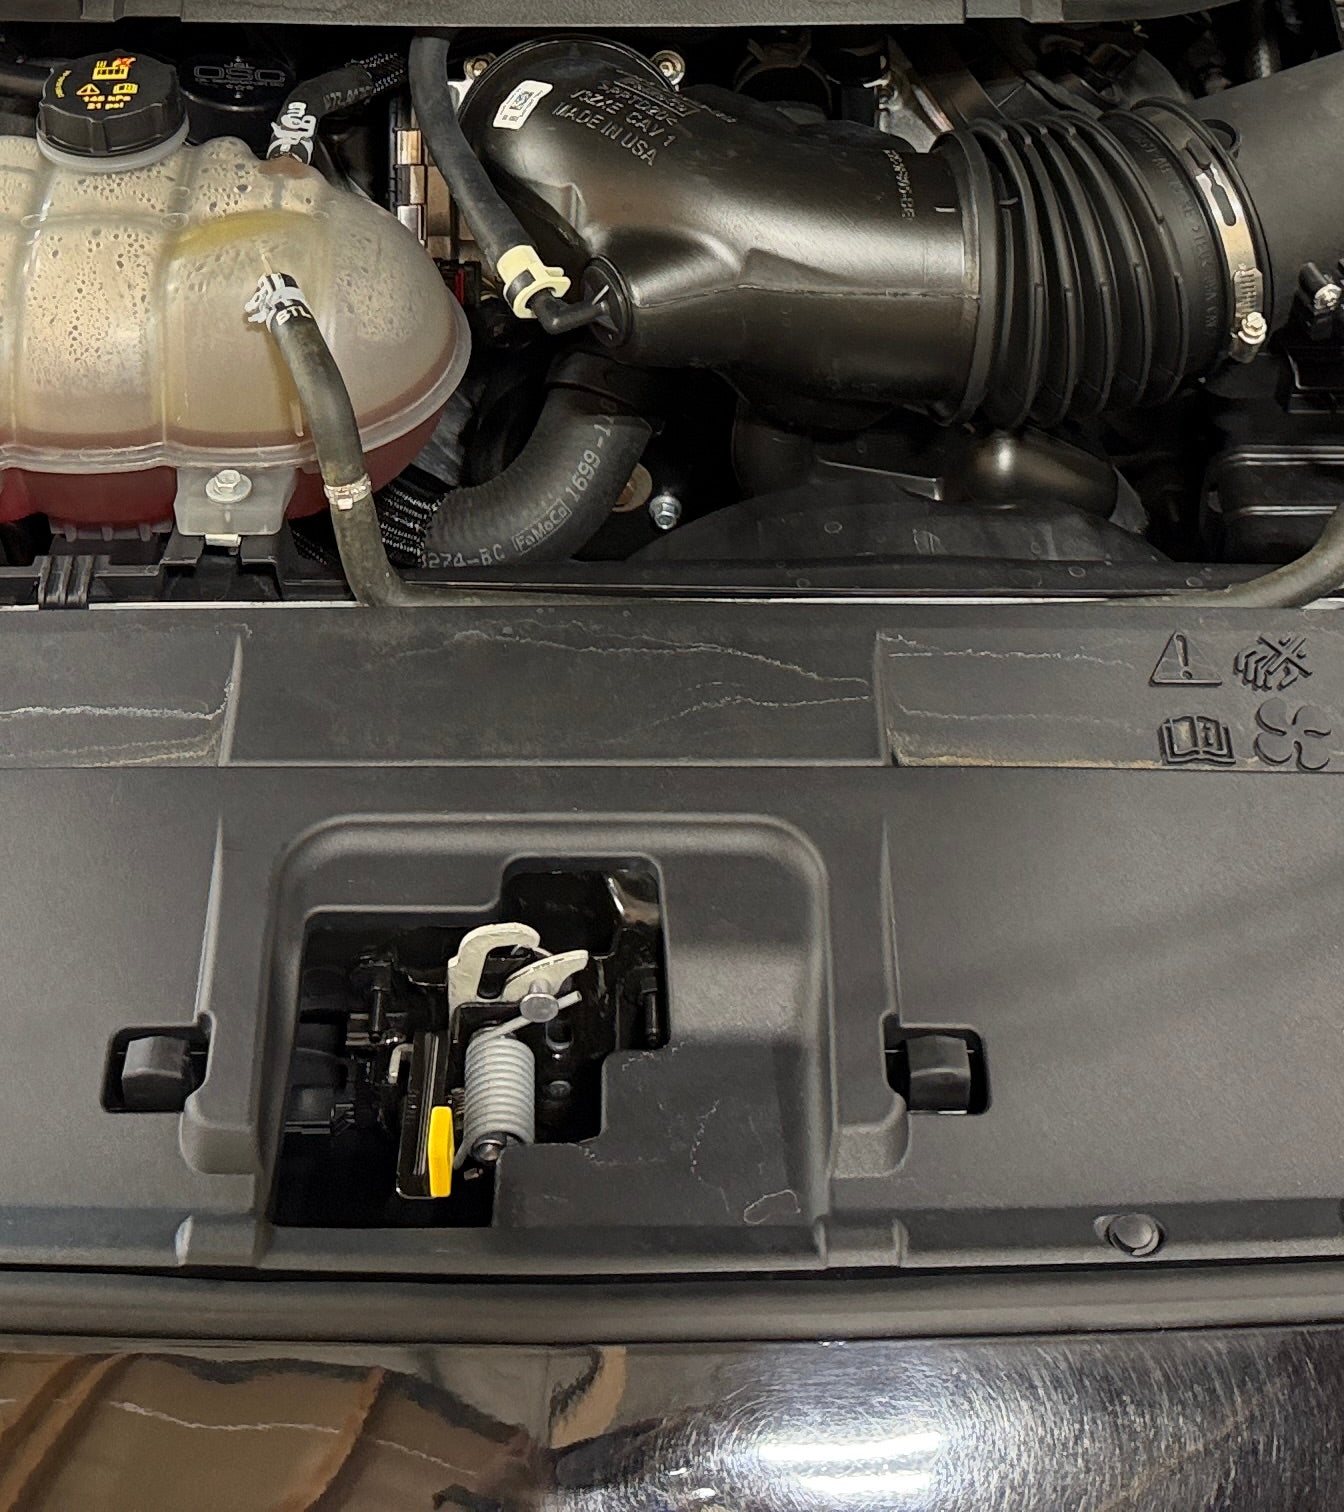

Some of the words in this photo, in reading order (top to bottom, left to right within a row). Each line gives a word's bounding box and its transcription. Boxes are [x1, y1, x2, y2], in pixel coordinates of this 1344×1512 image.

[552, 101, 605, 129] MADE
[600, 120, 623, 140] IN
[620, 132, 657, 167] USA
